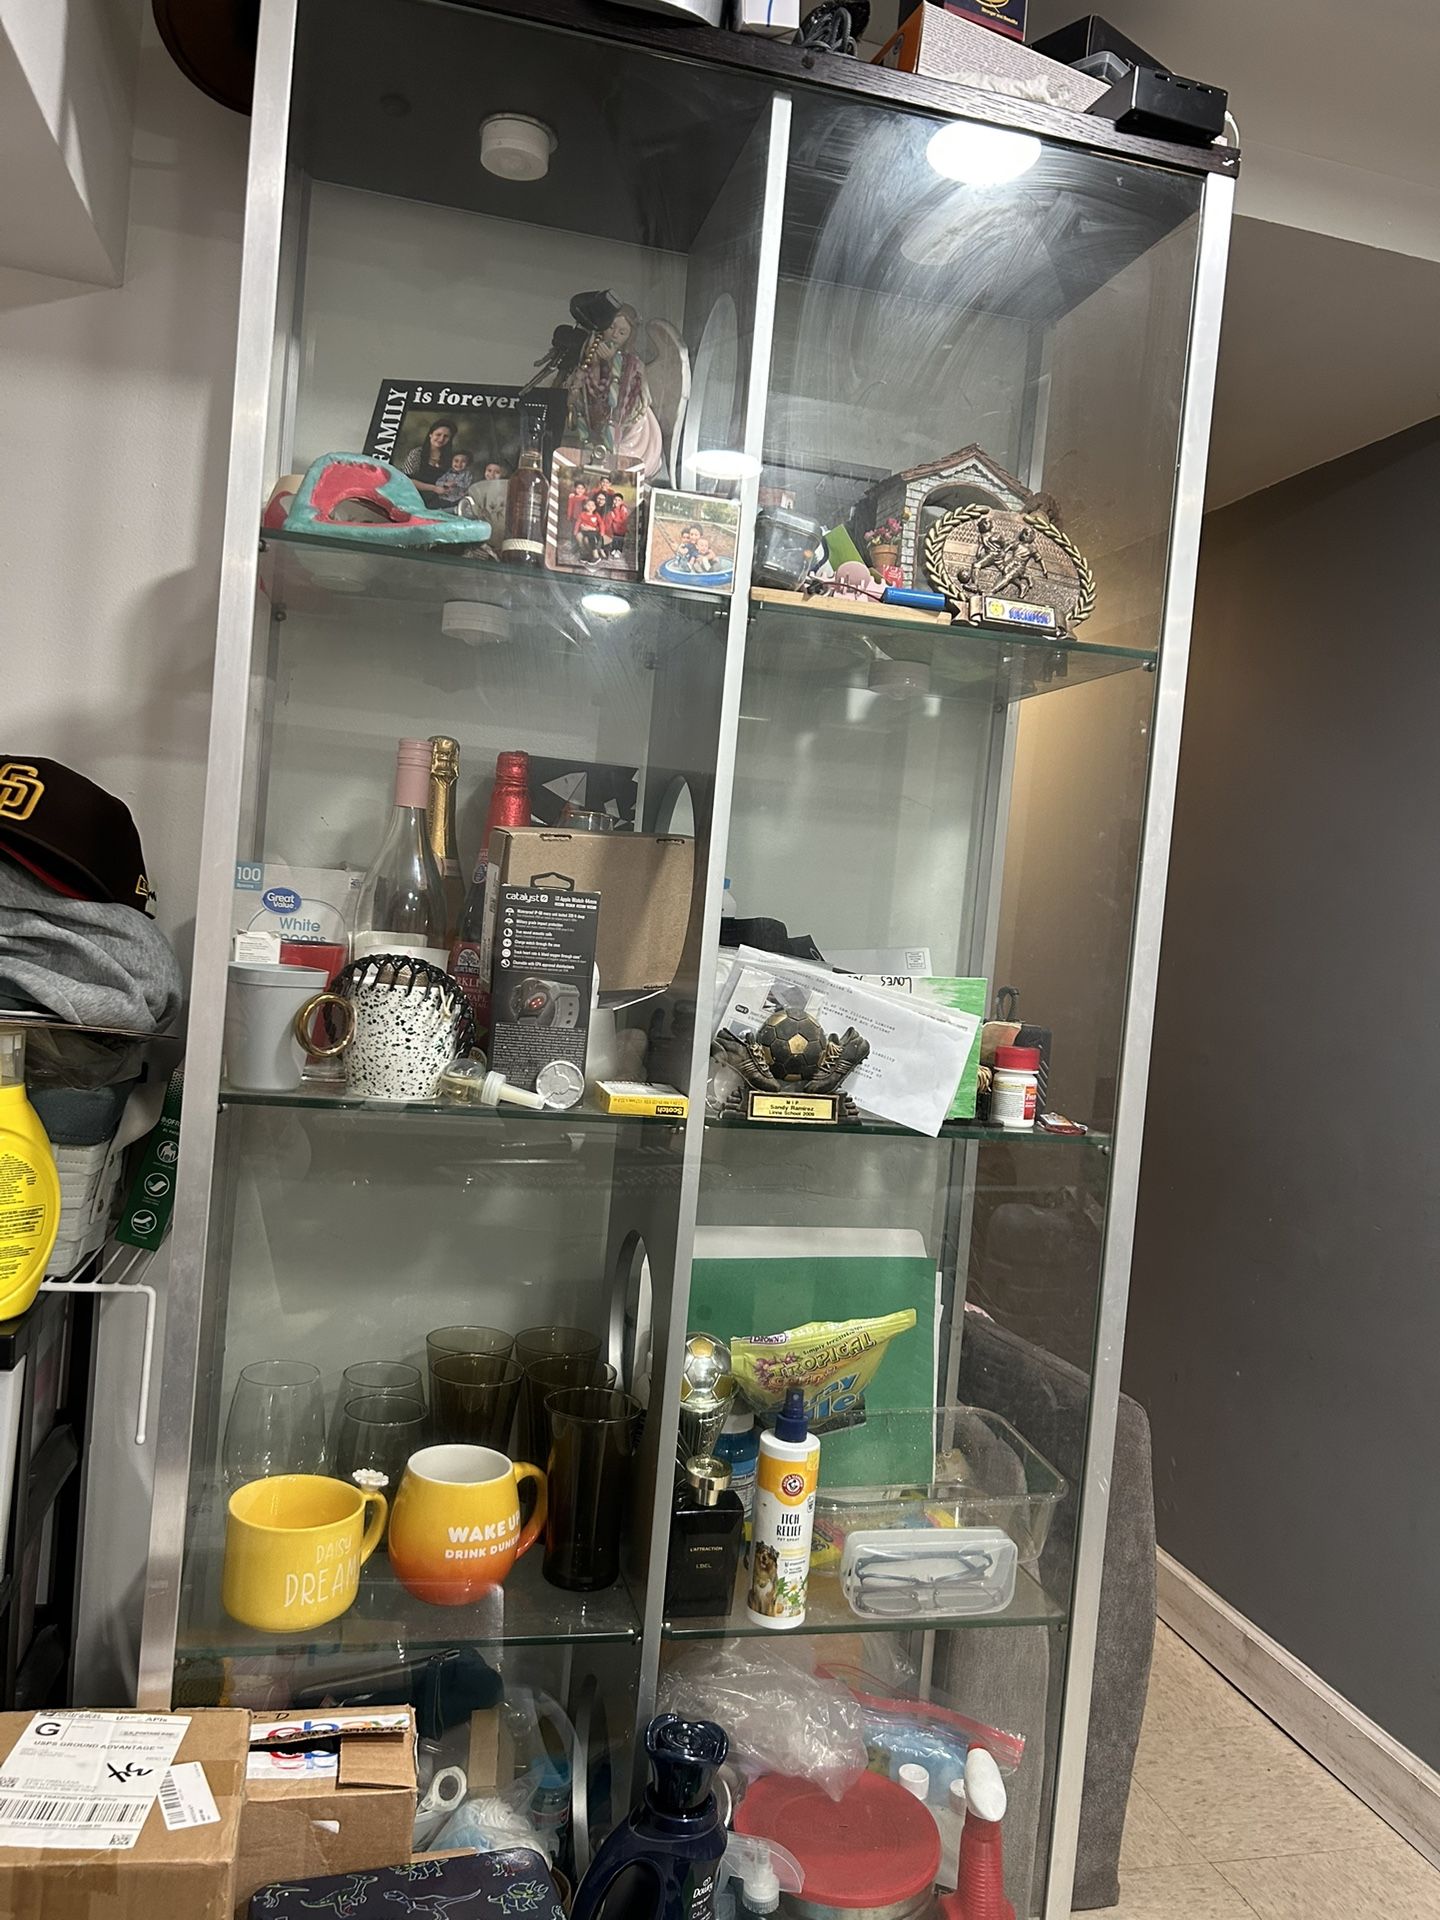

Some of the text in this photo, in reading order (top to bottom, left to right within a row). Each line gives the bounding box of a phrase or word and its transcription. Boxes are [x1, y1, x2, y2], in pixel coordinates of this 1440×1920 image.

[413, 386, 520, 409] is forever
[371, 387, 408, 464] FAMILY
[237, 866, 261, 881] 100
[267, 892, 295, 904] Great
[505, 891, 540, 904] catalyst
[272, 901, 295, 909] Value
[280, 917, 321, 932] White
[280, 933, 327, 942] poons
[657, 1106, 684, 1115] Scotch
[768, 1330, 878, 1379] TROPICAL
[780, 1513, 800, 1525] ITCH
[448, 1510, 521, 1544] WAKE UP
[776, 1525, 802, 1537] RELIEF
[316, 1535, 352, 1565] DAISY
[445, 1548, 487, 1560] DRINK
[35, 1722, 61, 1737] G
[59, 1741, 100, 1749] GROUND
